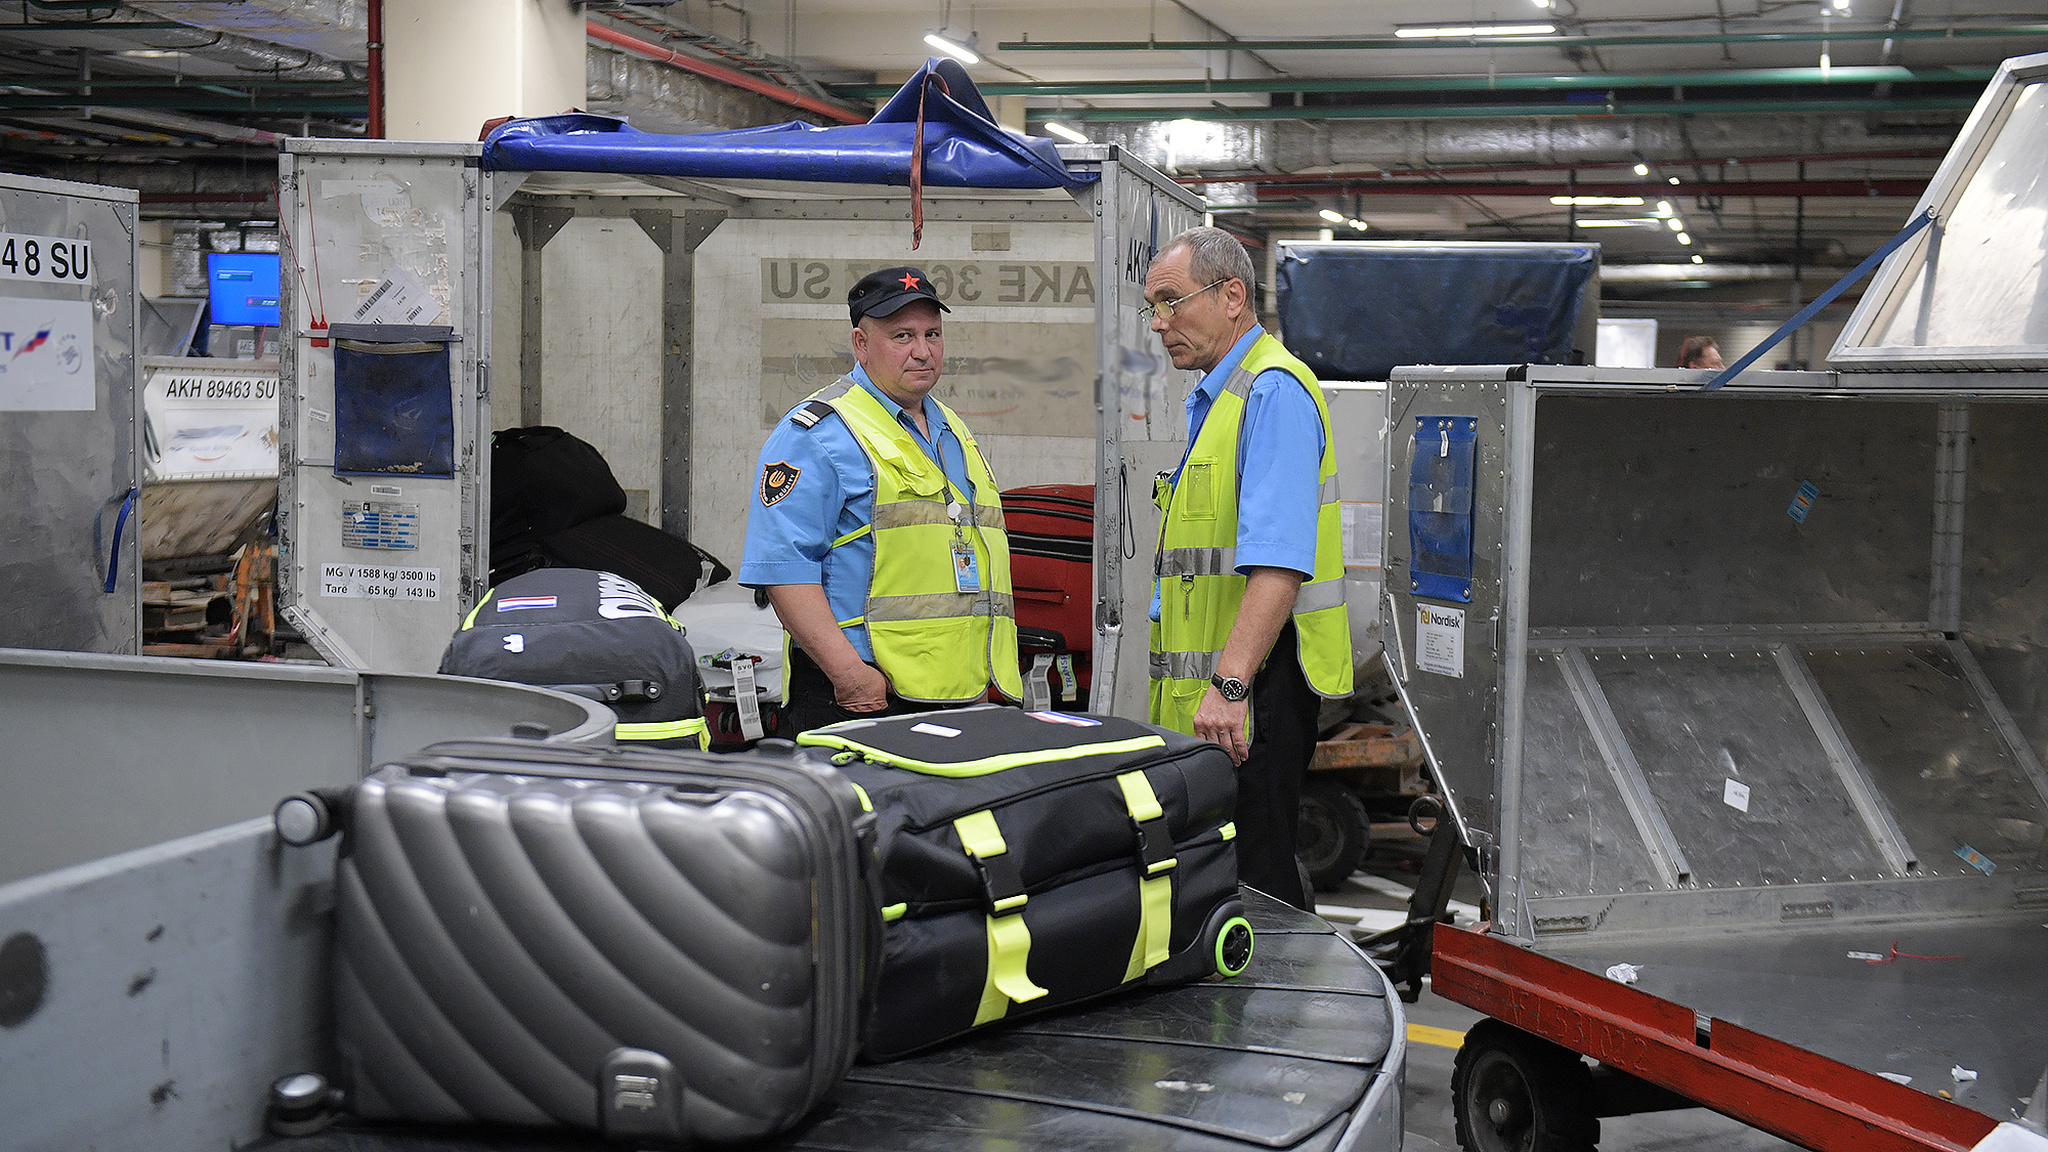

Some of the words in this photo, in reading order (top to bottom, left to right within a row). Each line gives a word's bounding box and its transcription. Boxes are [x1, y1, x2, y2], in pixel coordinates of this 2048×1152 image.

[51, 242, 89, 280] SU
[166, 378, 202, 398] AKH
[206, 379, 251, 399] 89463
[255, 380, 277, 399] SU
[357, 568, 381, 579] 1588
[383, 569, 398, 582] kg/
[400, 570, 423, 581] 3500
[426, 571, 436, 582] lb
[325, 584, 348, 594] Tare
[383, 586, 398, 598] kg/
[406, 587, 423, 597] 143
[426, 588, 436, 598] lb
[1431, 612, 1460, 629] Nordisk
